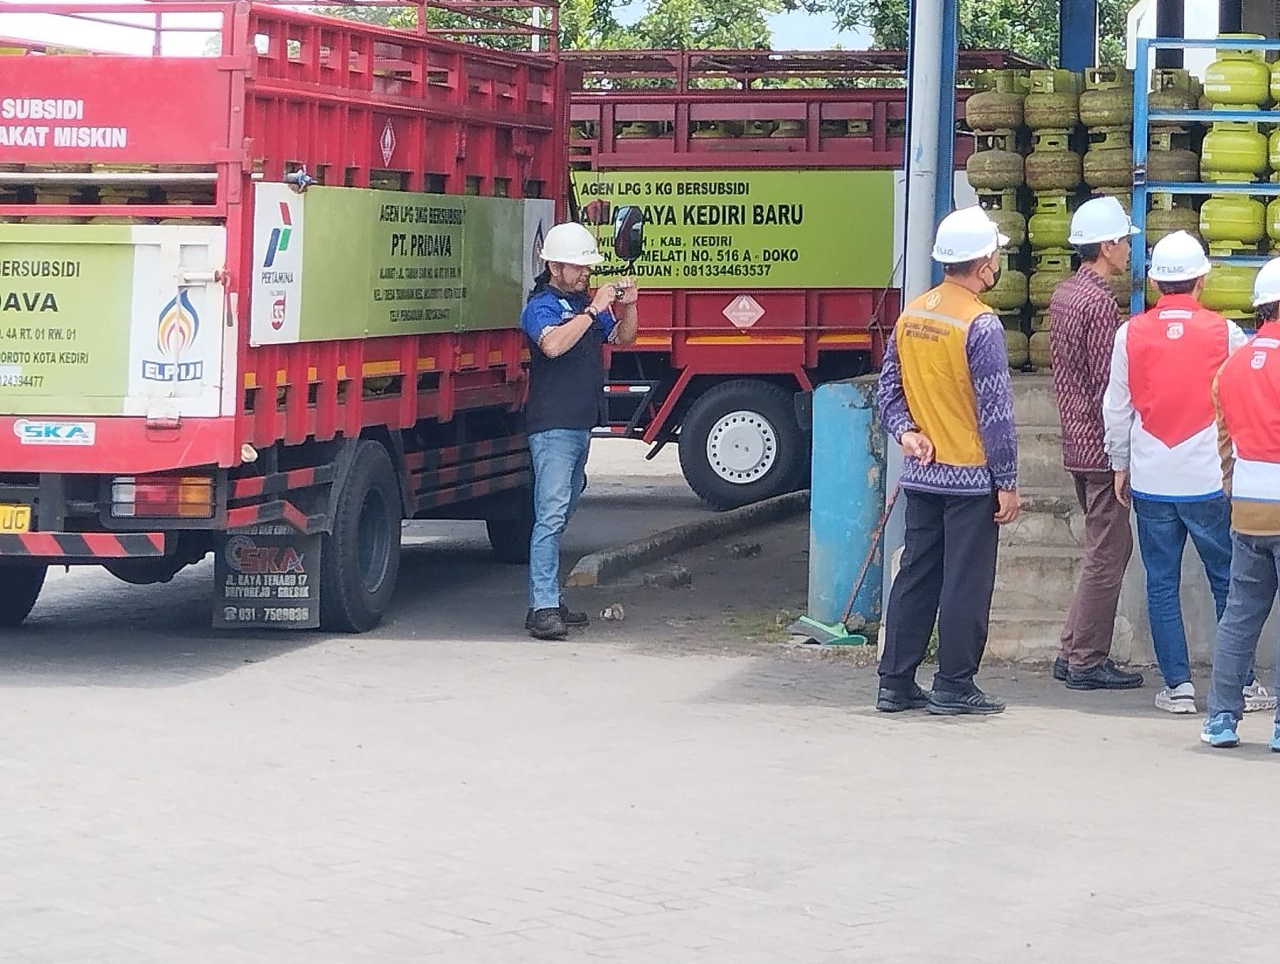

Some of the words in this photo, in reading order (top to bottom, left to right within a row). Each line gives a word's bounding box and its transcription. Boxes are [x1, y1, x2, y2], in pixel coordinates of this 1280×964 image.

[1, 98, 84, 120] SUBSIDI
[53, 127, 128, 147] MISKIN
[581, 182, 614, 196] AGEN
[618, 182, 641, 195] LPG
[645, 183, 652, 195] 3
[655, 183, 673, 195] KG
[677, 182, 750, 196] BERSUBSIDI
[683, 204, 746, 226] KEDIRI
[752, 203, 804, 226] BARU
[391, 233, 408, 257] PT.
[660, 236, 687, 247] KAB.
[692, 235, 732, 247] KEDIRI
[641, 250, 687, 263] MELATI
[691, 250, 713, 262] NO.
[716, 249, 739, 262] 516
[742, 249, 752, 262] A
[763, 249, 799, 262] DOKO
[0, 260, 81, 277] ERSUBSIDI
[683, 264, 772, 277] 081334463537
[0, 292, 59, 312] AVA
[33, 351, 57, 364] KOTA
[59, 351, 90, 365] KEDIRI
[143, 360, 203, 382] ELPIJI
[23, 425, 90, 439] SKA
[240, 546, 305, 574] SKA
[238, 607, 256, 621] 031
